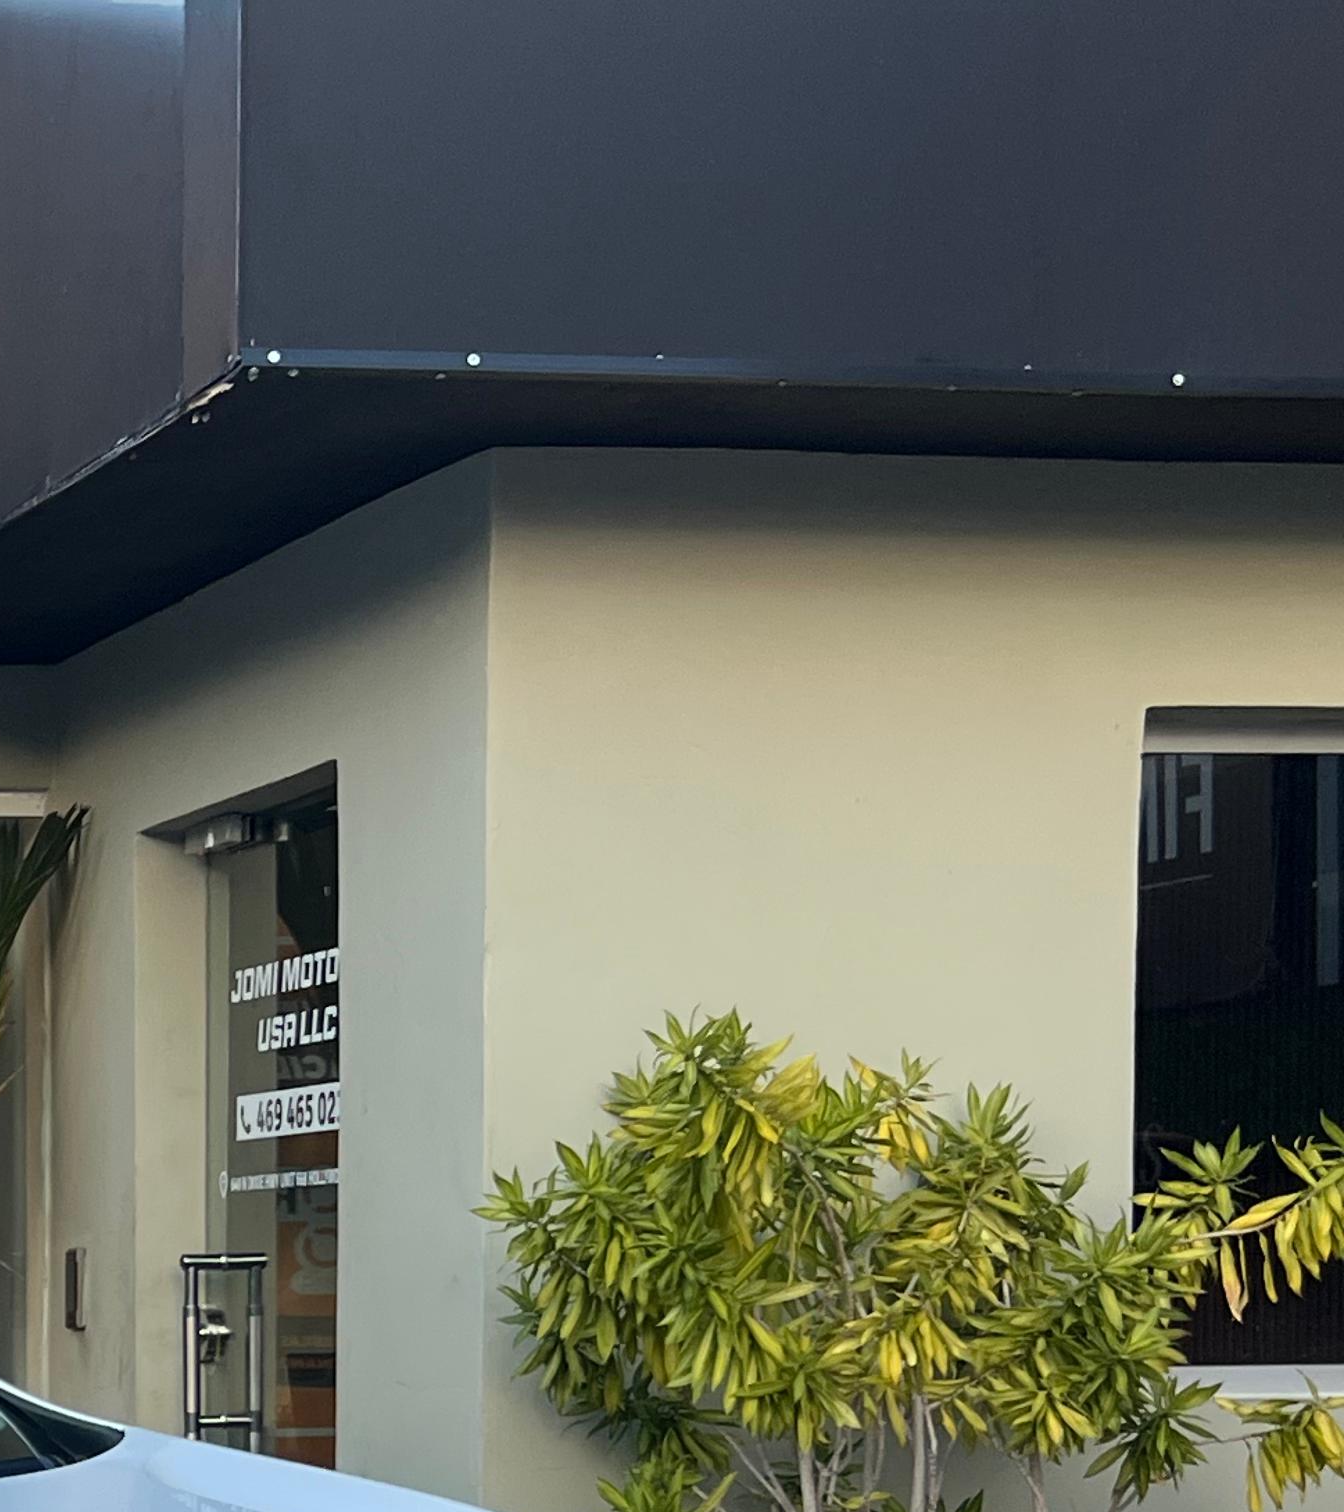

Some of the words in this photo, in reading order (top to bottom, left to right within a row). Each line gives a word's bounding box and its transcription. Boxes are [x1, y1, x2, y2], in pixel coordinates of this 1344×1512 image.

[230, 960, 279, 1003] JOMI
[257, 1010, 297, 1052] USA
[299, 1005, 338, 1045] LLC
[257, 1098, 282, 1132] 469
[287, 1094, 313, 1129] 465
[317, 1090, 341, 1126] 02
